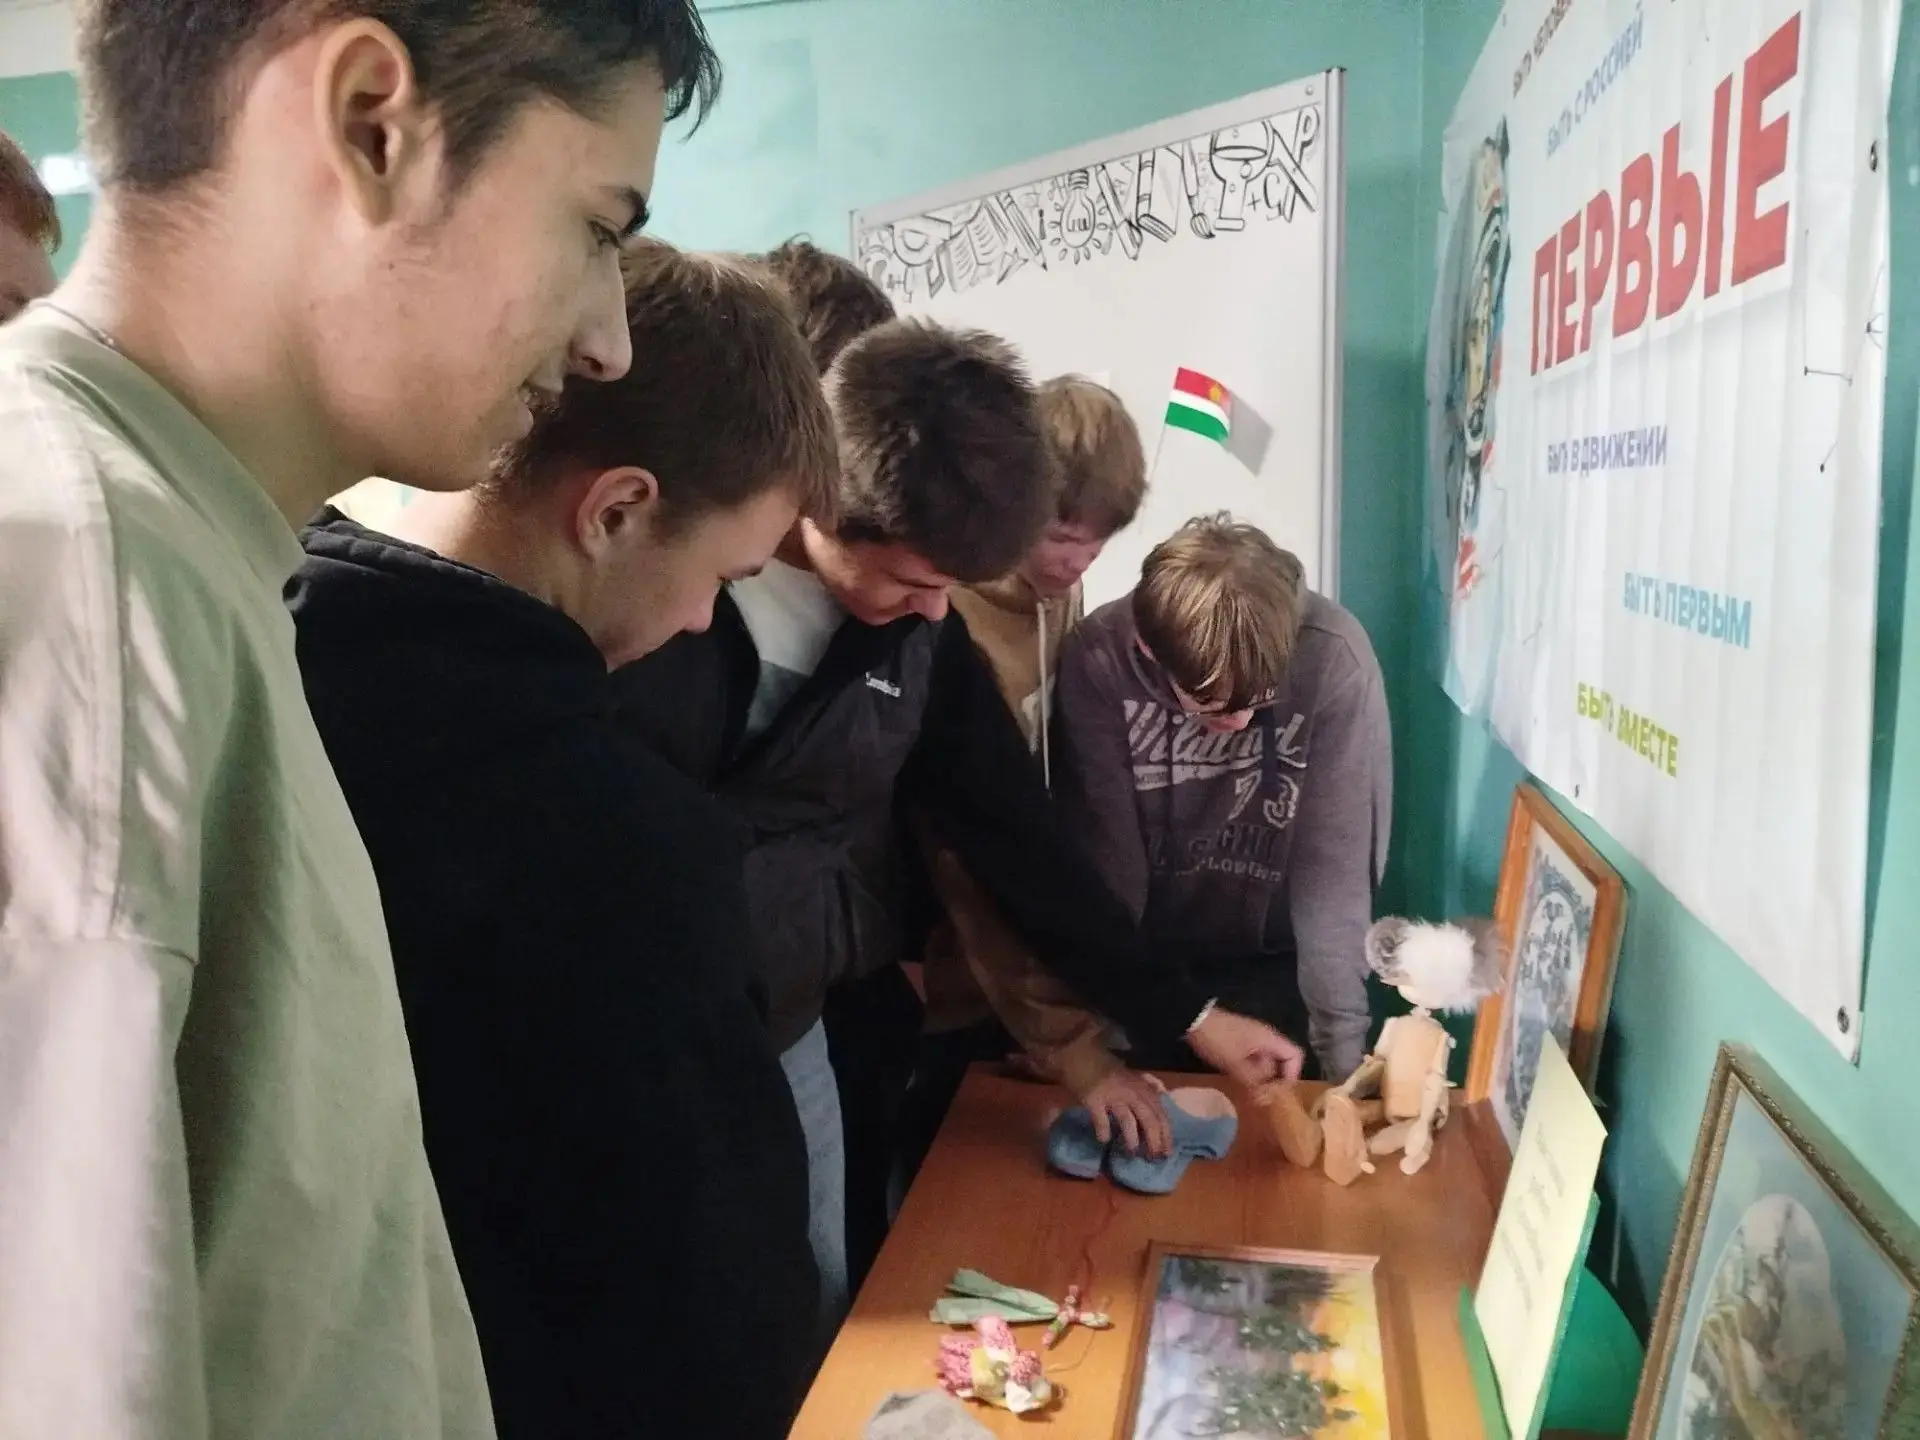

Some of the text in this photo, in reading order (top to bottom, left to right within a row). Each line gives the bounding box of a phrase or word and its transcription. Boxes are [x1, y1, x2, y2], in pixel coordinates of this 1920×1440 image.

[1530, 10, 1801, 377] ПЕРВЫЕ
[1571, 439, 1580, 472] В
[1664, 581, 1752, 650] ПЕРВЫМ
